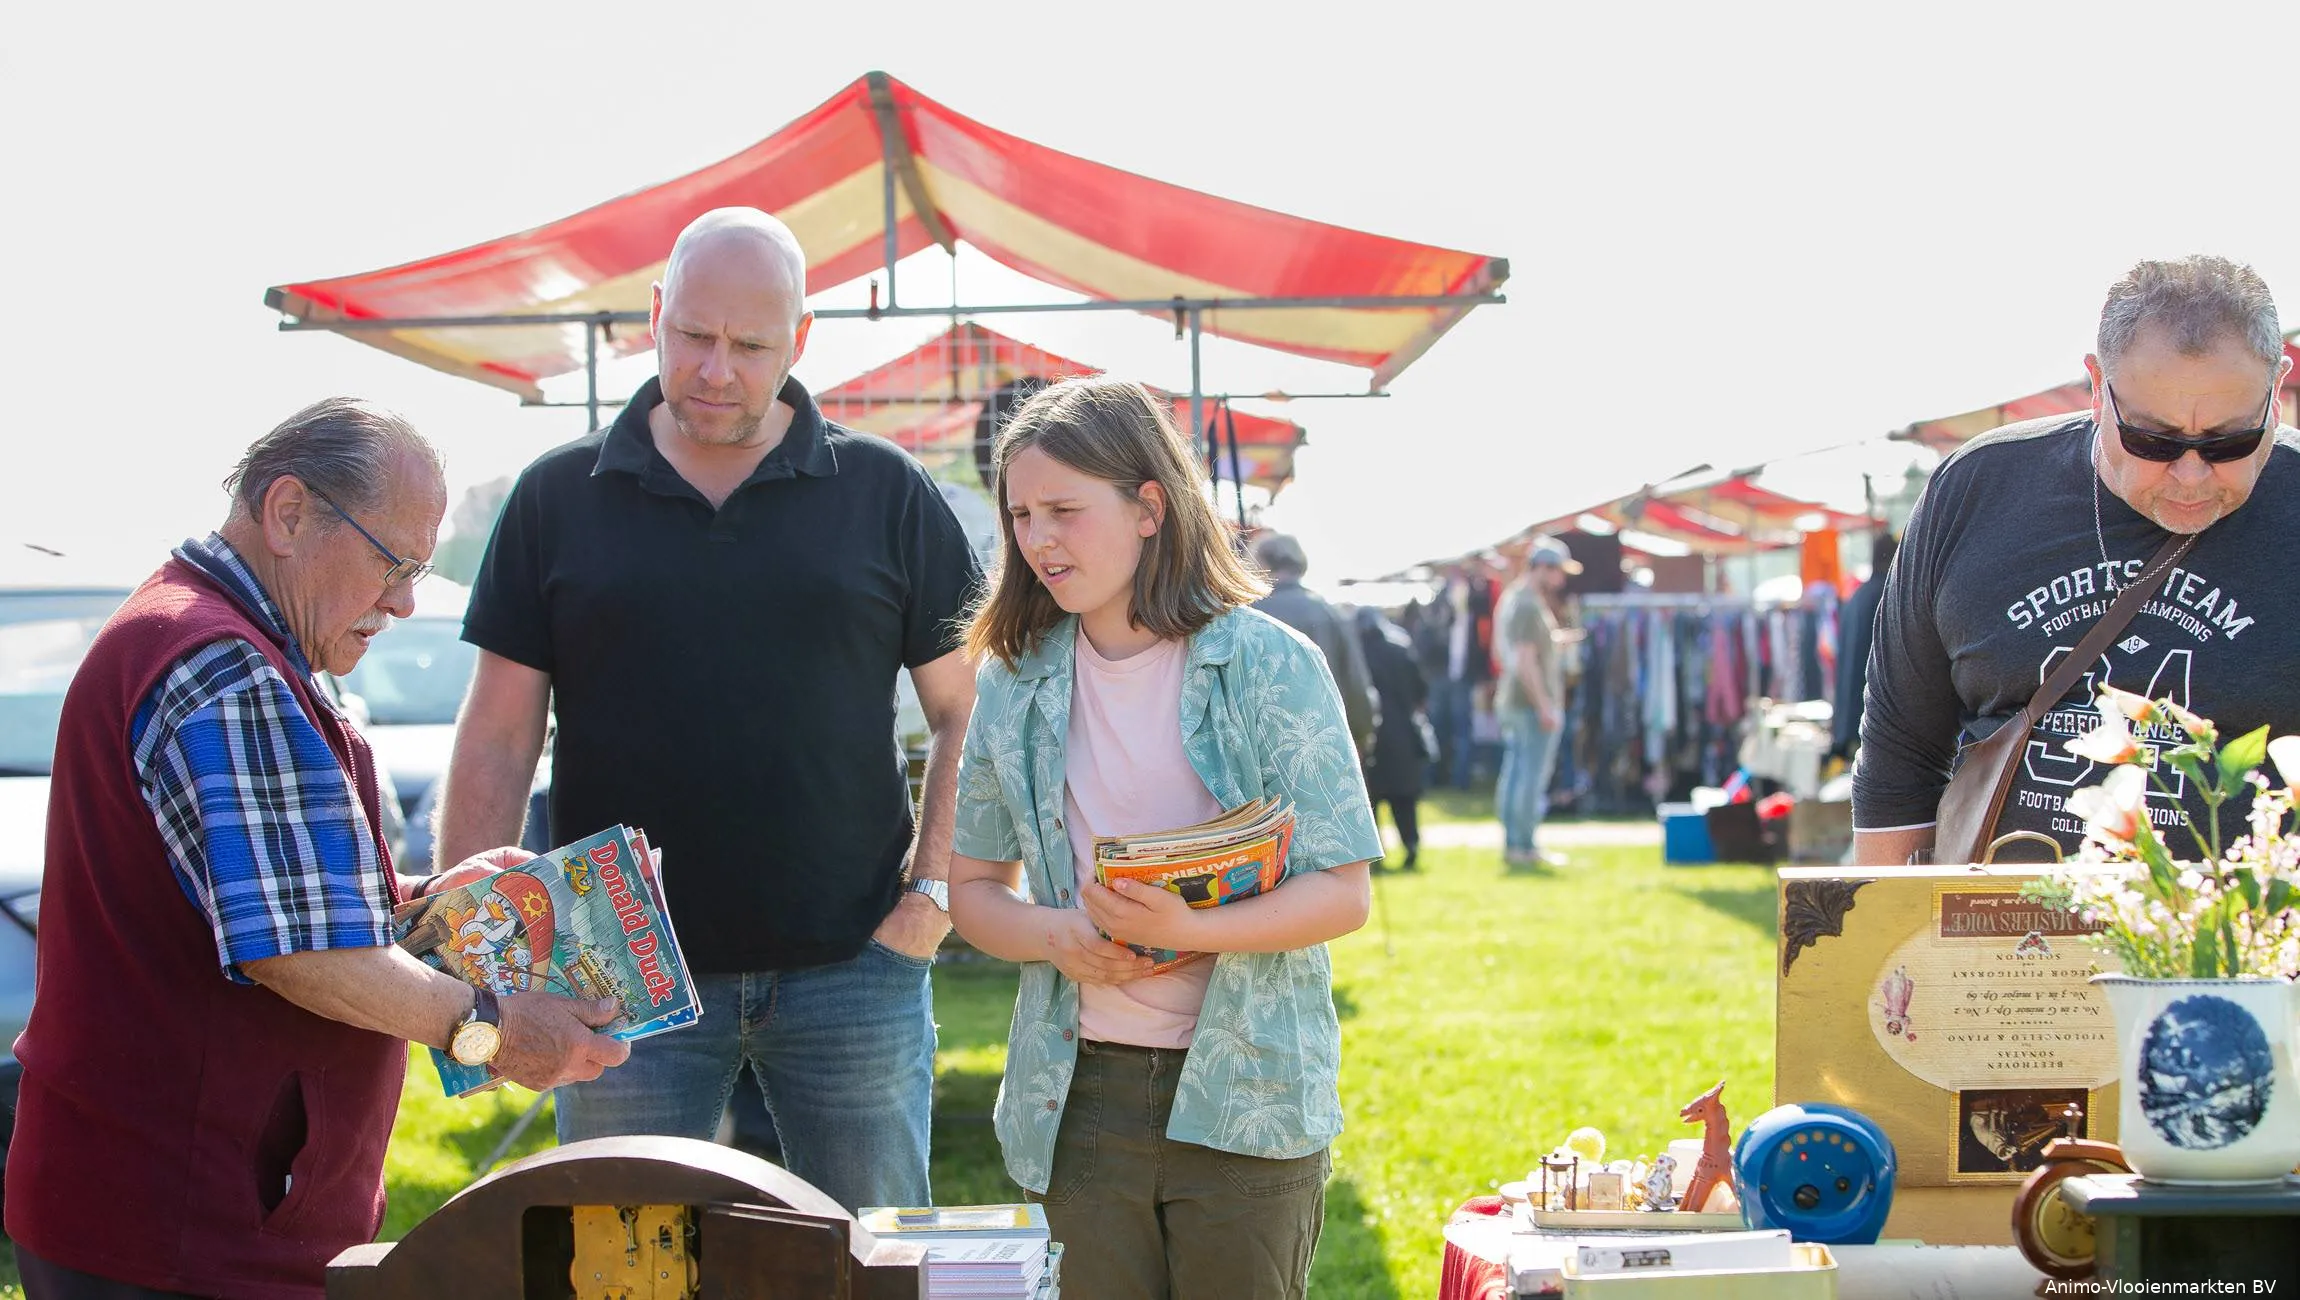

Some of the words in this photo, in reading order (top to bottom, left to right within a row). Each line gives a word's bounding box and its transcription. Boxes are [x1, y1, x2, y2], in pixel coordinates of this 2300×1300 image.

[2162, 567, 2255, 640] TEAM
[2041, 598, 2117, 637] FOOTBAL
[2137, 600, 2213, 643] HAMPIONS
[2127, 638, 2140, 650] 19
[2041, 712, 2185, 741] PERFOANCE
[1160, 854, 1249, 881] NIEUWS
[1969, 898, 1999, 907] Record
[589, 839, 650, 936] Donald
[628, 930, 676, 1007] Duck
[1999, 911, 2072, 933] MASTER'S
[1951, 970, 2043, 978] PIATIGORSKY
[2051, 970, 2104, 978] REGOR
[1966, 993, 1977, 1001] 69
[1981, 991, 1998, 1001] Op.
[2002, 990, 2031, 1000] major
[2036, 992, 2045, 1000] A
[1963, 1008, 1981, 1017] No.
[1994, 1005, 2012, 1016] Op.
[2015, 1007, 2045, 1015] minor
[2047, 1007, 2056, 1016] G
[2060, 1007, 2070, 1015] in
[1947, 1034, 1989, 1042] PIANO
[2011, 1033, 2105, 1041] VIOLONCELLO
[1986, 1061, 2063, 1069] BEETHOVEN
